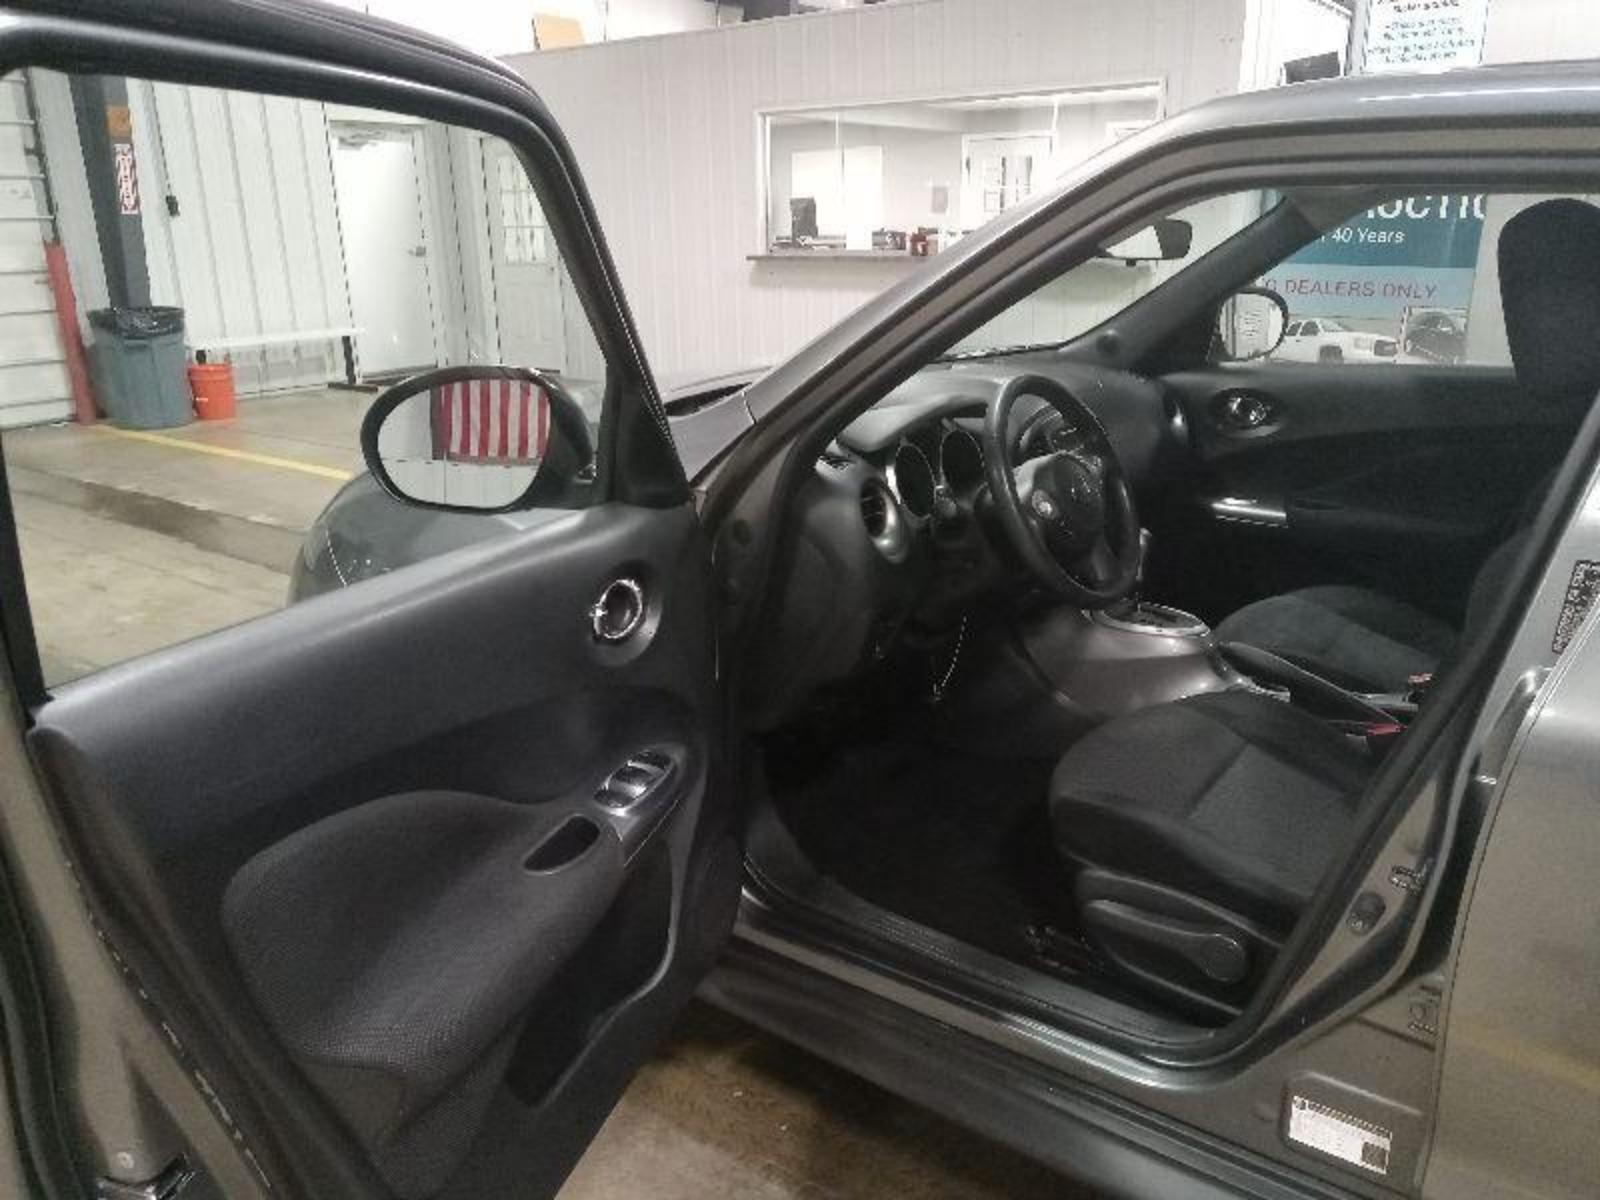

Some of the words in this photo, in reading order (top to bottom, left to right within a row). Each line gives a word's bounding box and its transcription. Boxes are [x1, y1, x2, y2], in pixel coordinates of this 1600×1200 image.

[1331, 227, 1353, 243] 40
[1357, 227, 1405, 244] Years
[1285, 279, 1376, 297] DEALERS
[1383, 282, 1437, 299] ONLY
